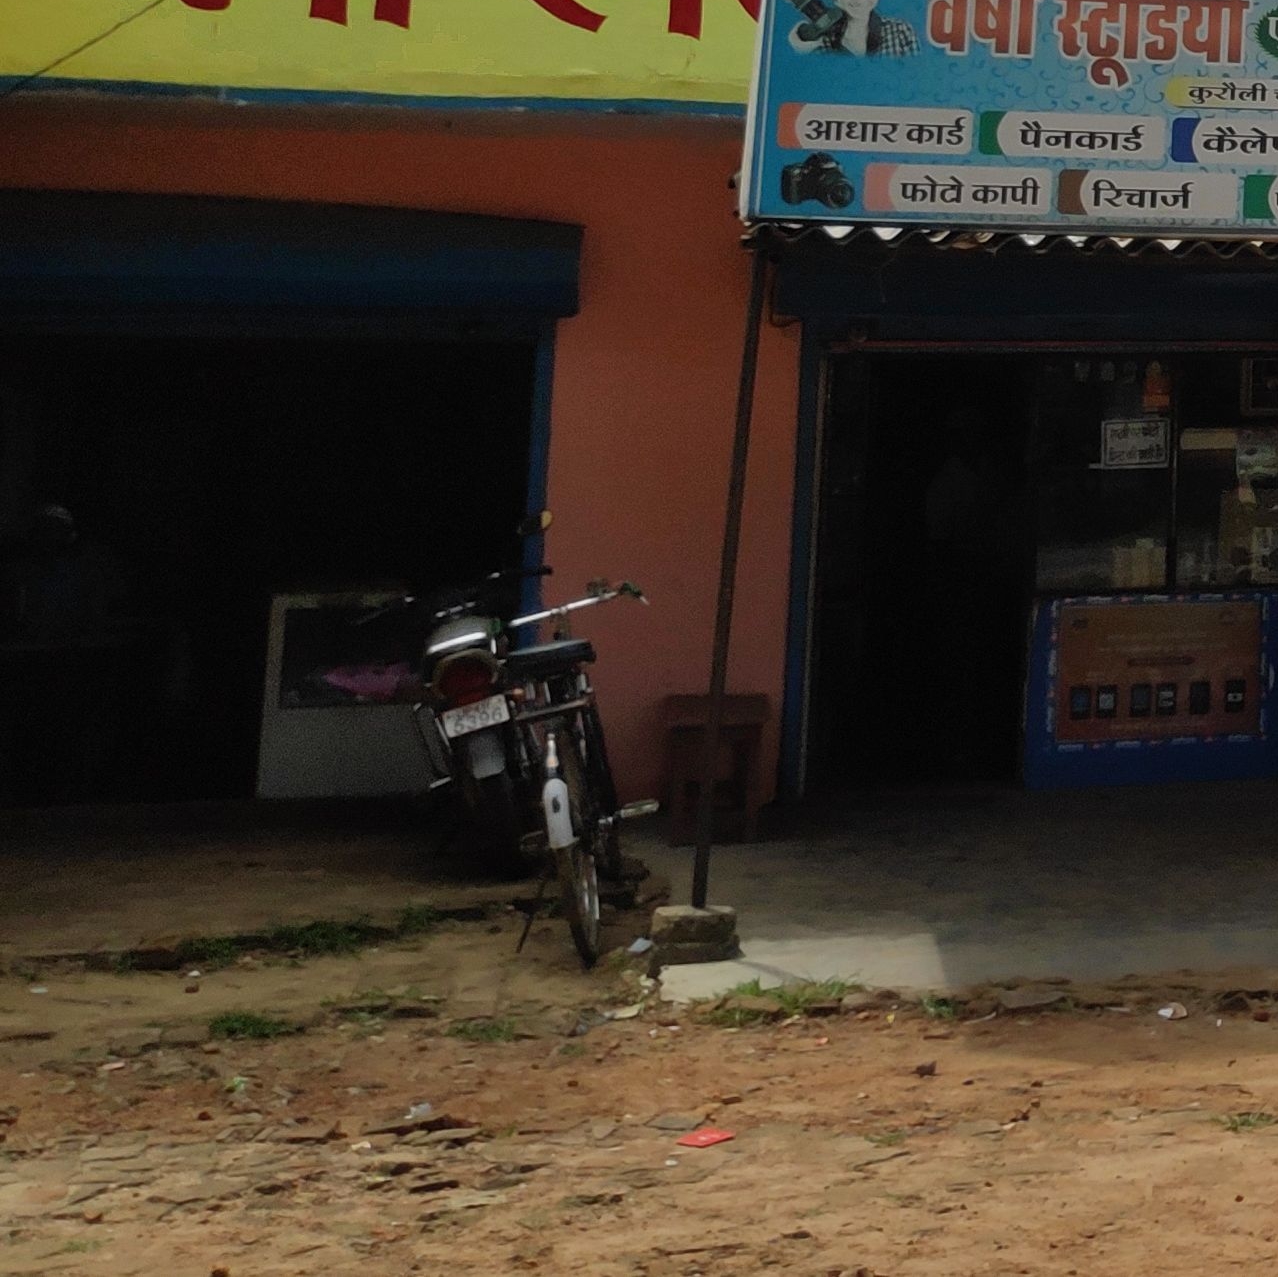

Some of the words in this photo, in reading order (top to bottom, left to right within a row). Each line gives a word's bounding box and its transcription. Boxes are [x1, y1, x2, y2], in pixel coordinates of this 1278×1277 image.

[1188, 81, 1268, 105] कुरौली
[805, 118, 899, 144] आधार
[906, 115, 969, 146] कार्ड
[1019, 120, 1146, 152] पैनकार्ड
[900, 174, 965, 204] फोटो
[971, 176, 1042, 206] कापी
[1092, 178, 1195, 209] रिचार्ज
